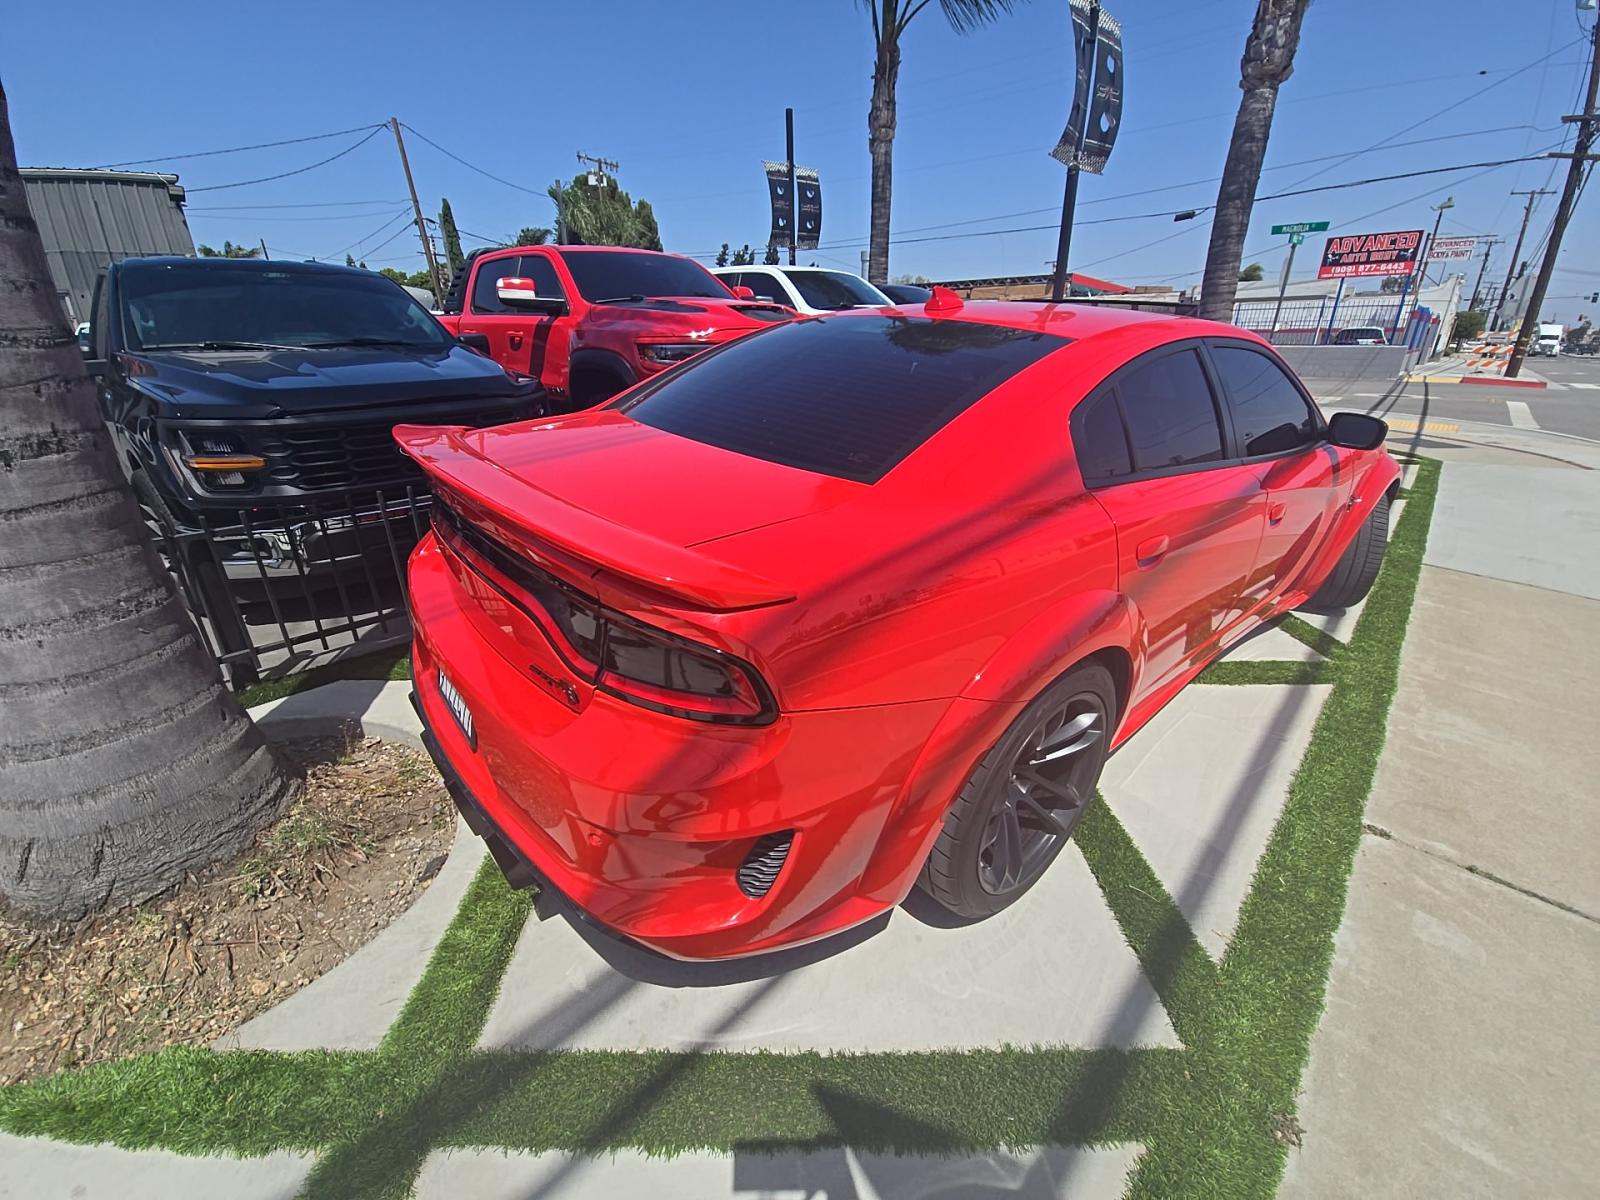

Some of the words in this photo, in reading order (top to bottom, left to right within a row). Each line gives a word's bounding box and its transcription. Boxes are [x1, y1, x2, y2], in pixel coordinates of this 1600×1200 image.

[1328, 232, 1419, 254] ADVANCED
[1435, 240, 1474, 248] ADVANCED
[1340, 252, 1368, 263] AUTO
[1369, 250, 1399, 261] BODY
[1331, 265, 1356, 273] (909)
